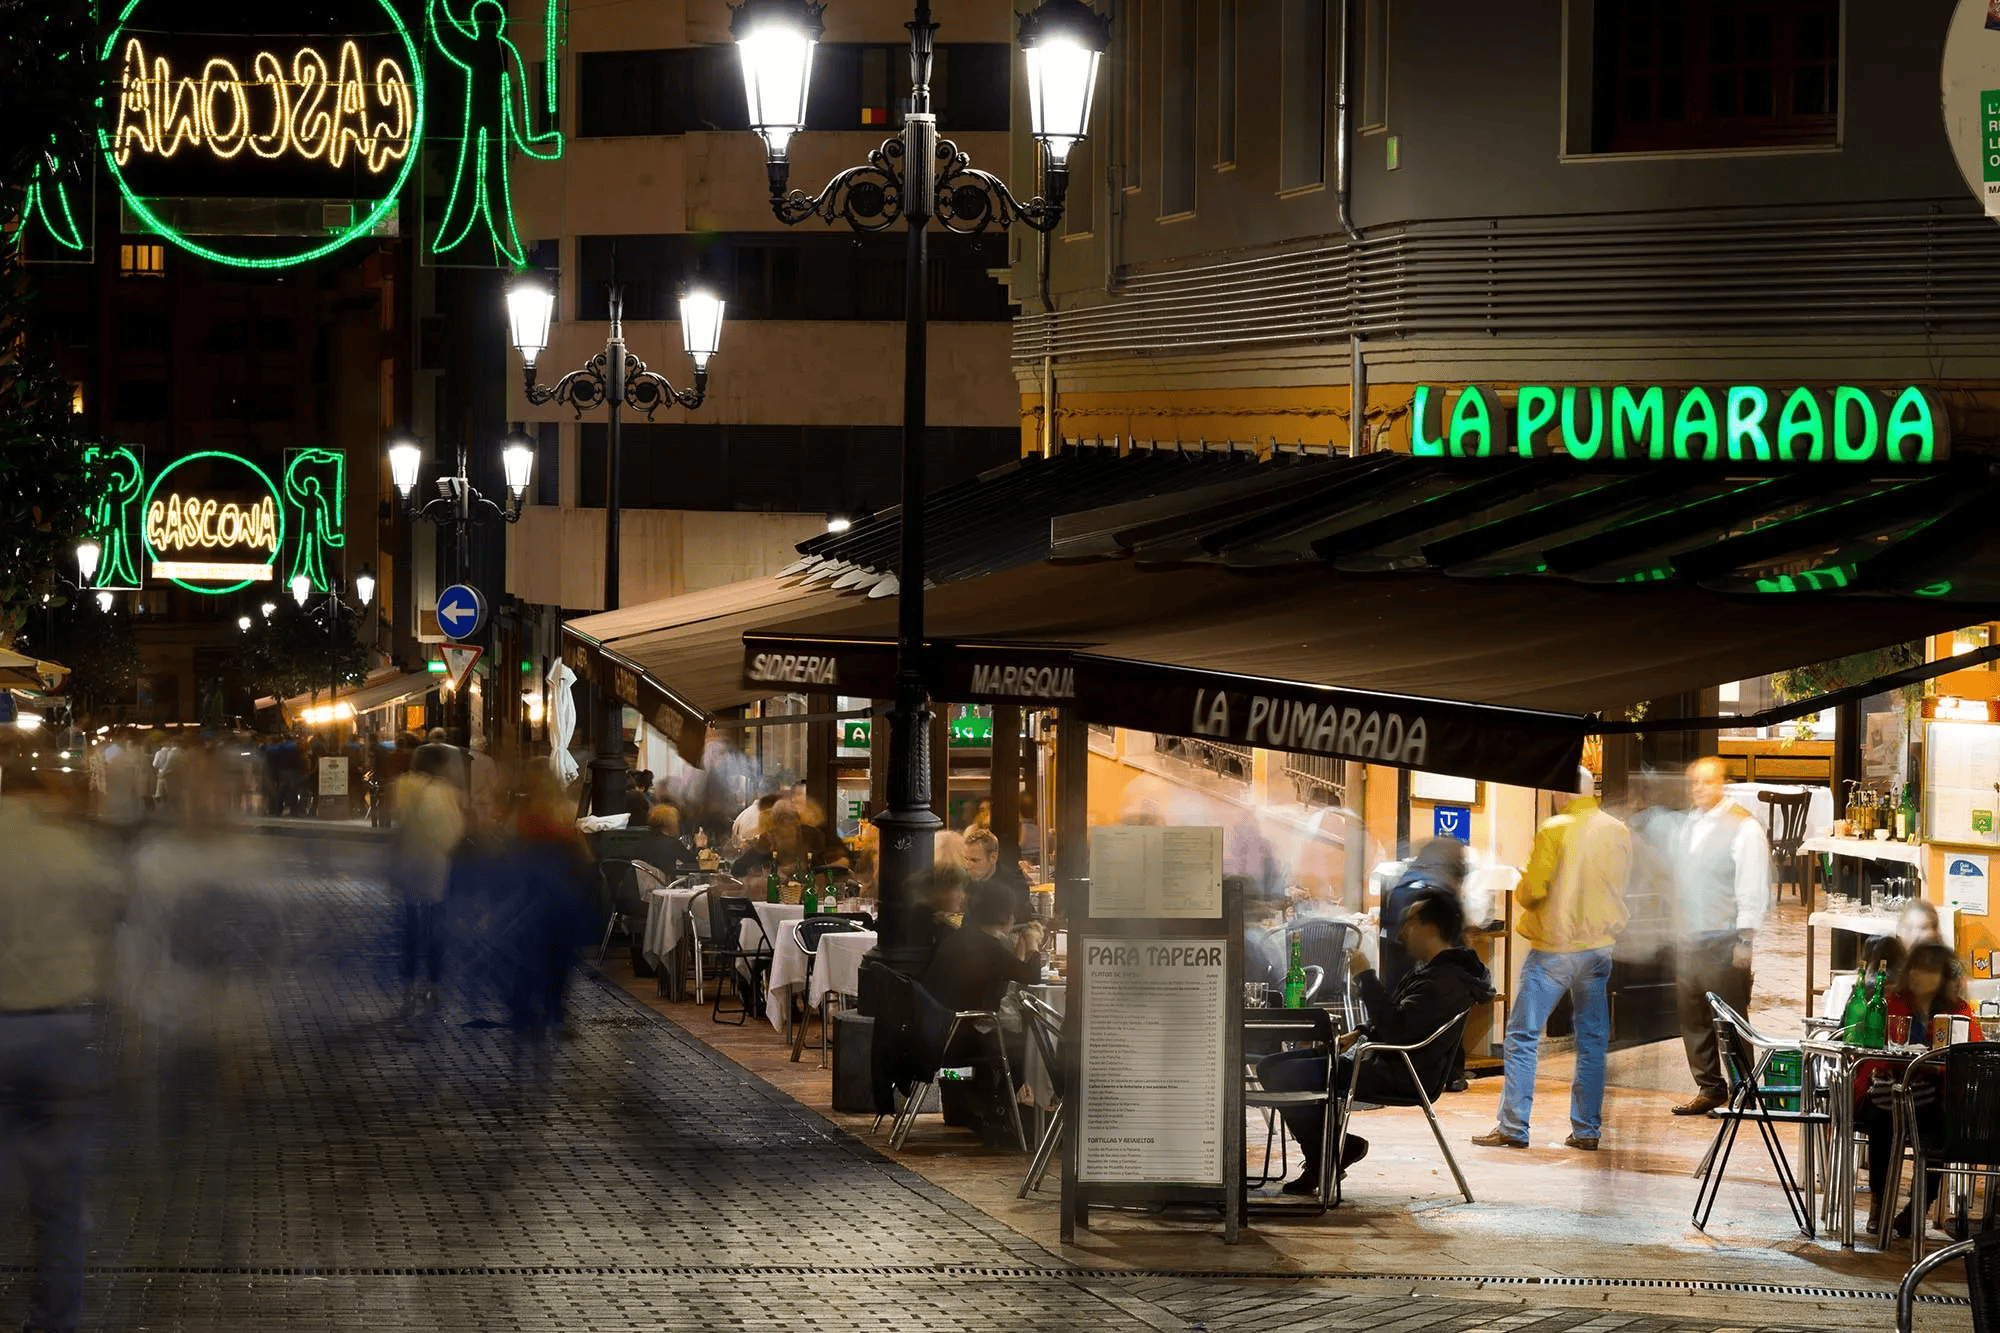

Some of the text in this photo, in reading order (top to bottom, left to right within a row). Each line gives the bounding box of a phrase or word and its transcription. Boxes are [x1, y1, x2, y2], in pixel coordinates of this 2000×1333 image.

[1411, 384, 1935, 463] LA PUMARADA
[147, 493, 278, 552] GASCONA
[749, 653, 837, 685] SIDRERIA
[1192, 688, 1428, 766] LA PUMARADA
[1088, 945, 1222, 967] PARA TAPEAR
